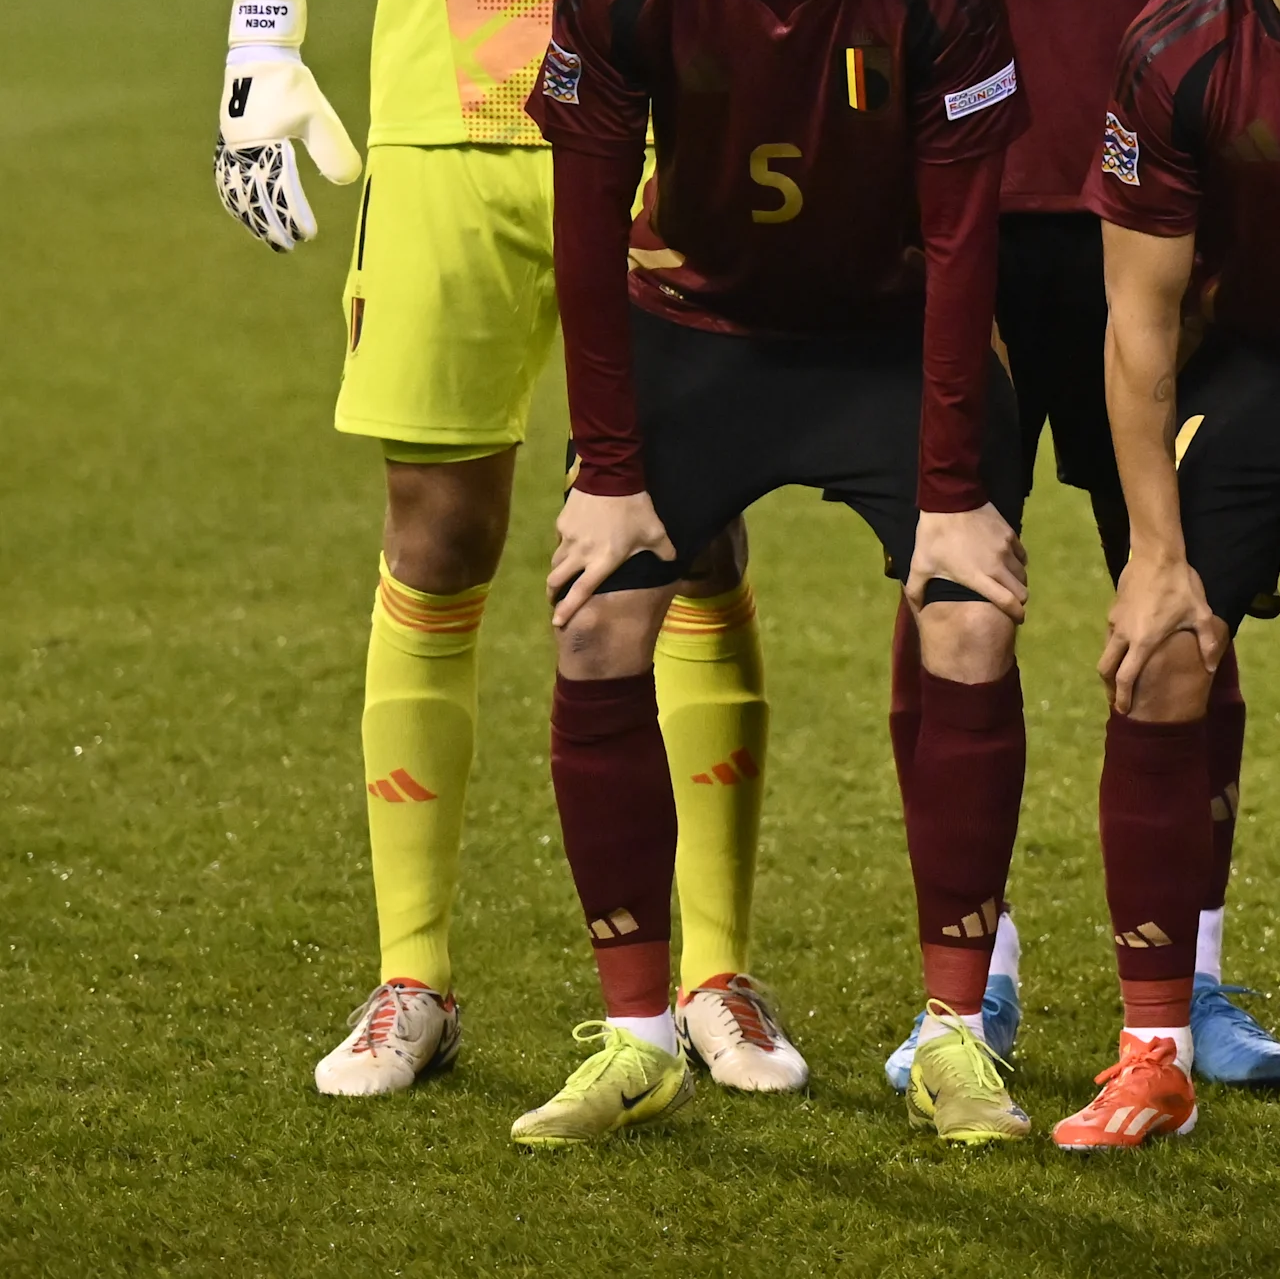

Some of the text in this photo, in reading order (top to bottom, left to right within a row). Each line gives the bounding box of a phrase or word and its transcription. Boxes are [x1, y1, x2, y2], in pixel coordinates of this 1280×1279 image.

[239, 5, 288, 16] CASTEELS
[246, 19, 276, 29] KOEN
[948, 92, 968, 103] UEFA
[751, 143, 803, 224] 5
